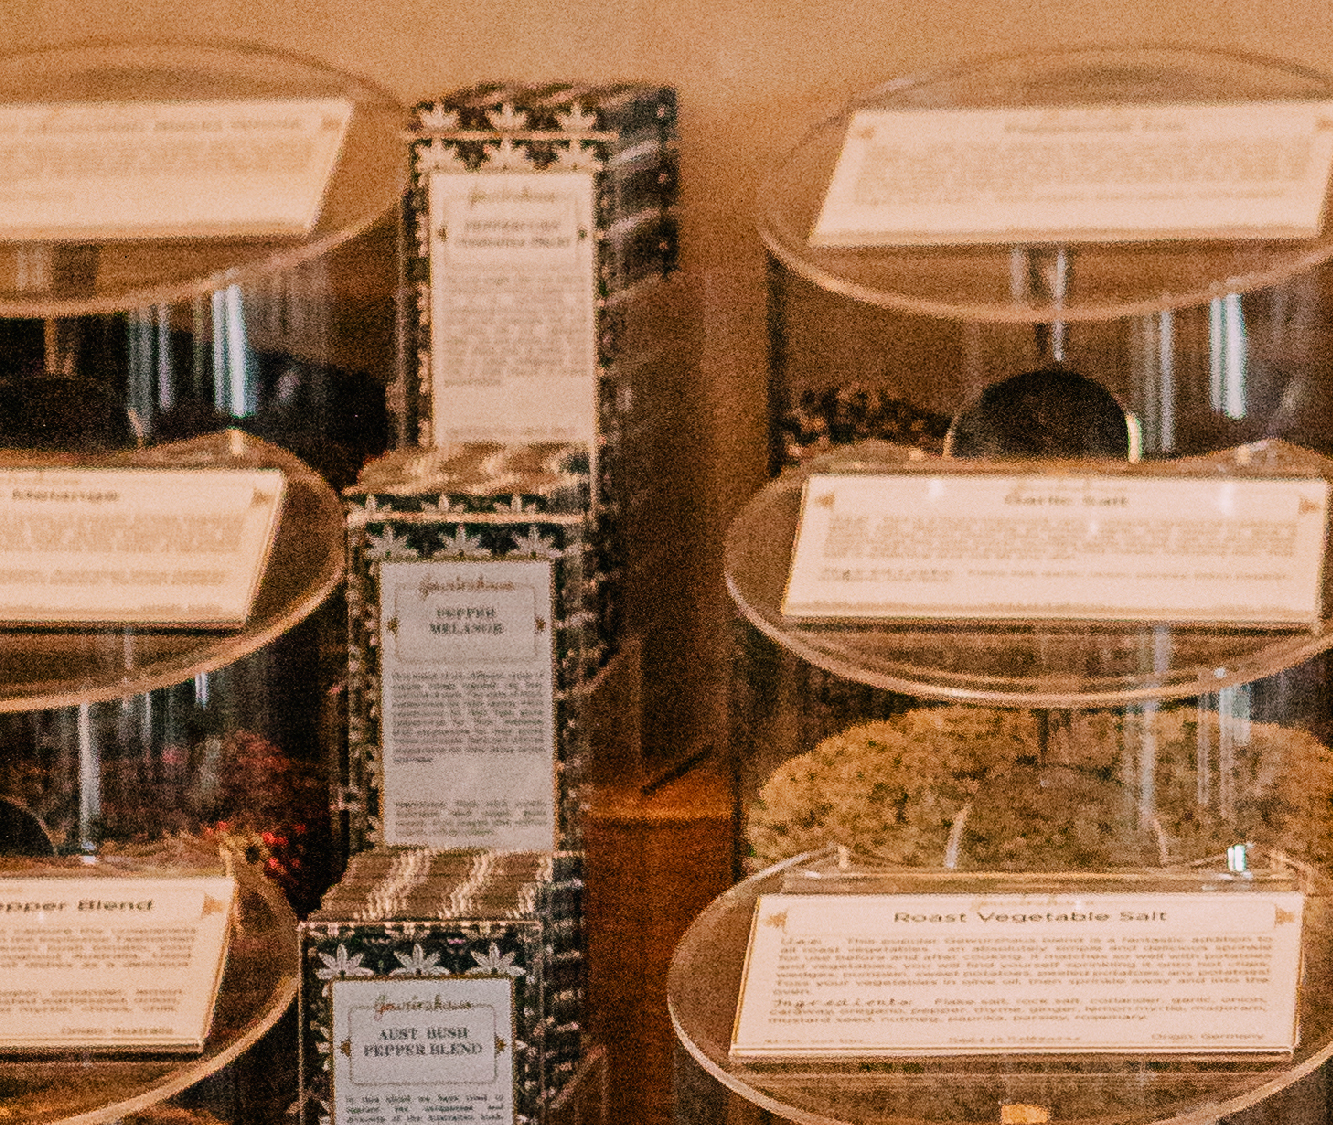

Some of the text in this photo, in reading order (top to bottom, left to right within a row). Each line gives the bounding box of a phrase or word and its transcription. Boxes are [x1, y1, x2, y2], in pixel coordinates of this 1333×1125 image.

[0, 899, 154, 913] pper Blend
[895, 910, 1167, 924] Roast Vegetable Salt
[379, 1026, 470, 1041] AUST BUSH
[363, 1043, 484, 1057] PEPPER BLEND
